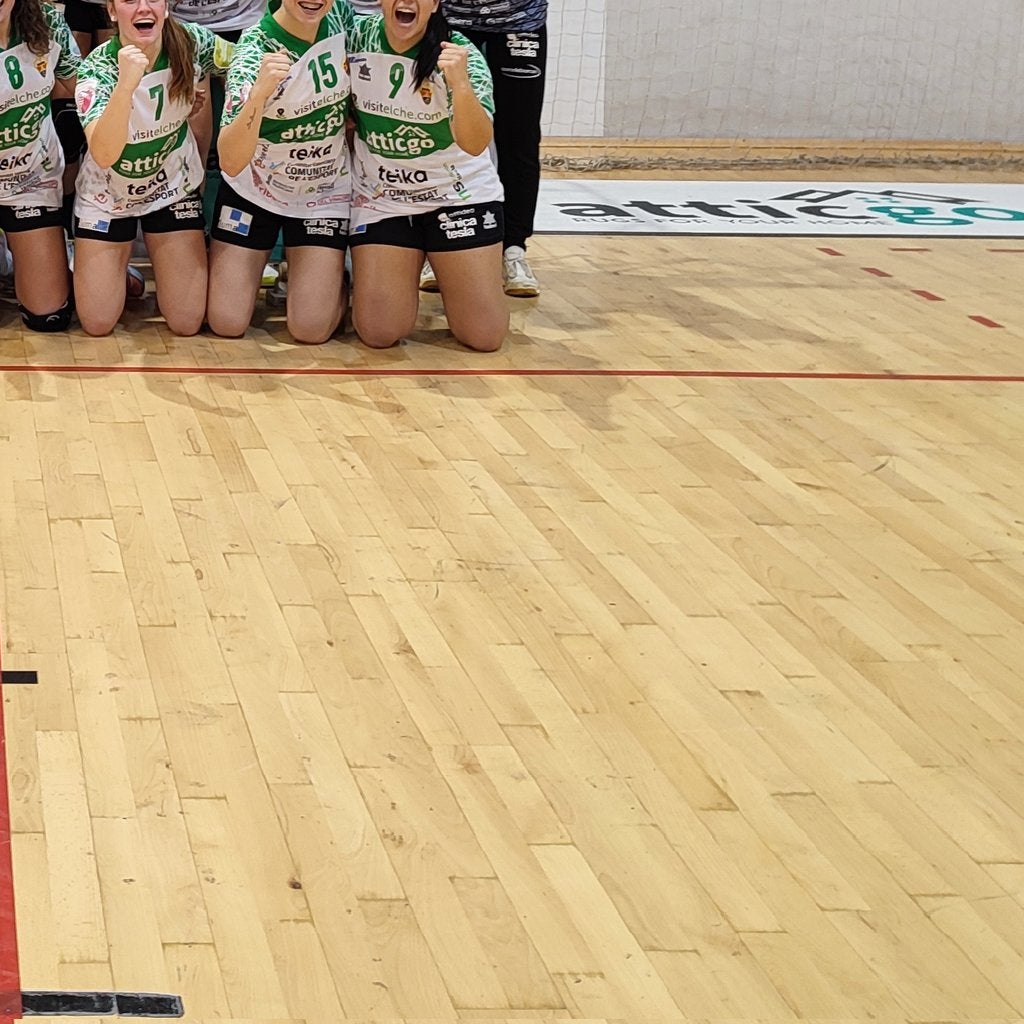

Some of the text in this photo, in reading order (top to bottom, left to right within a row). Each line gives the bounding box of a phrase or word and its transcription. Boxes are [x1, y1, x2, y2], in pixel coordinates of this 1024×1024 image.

[4, 55, 24, 90] 8
[308, 51, 339, 94] 15
[388, 62, 405, 99] 9
[148, 83, 164, 121] 7
[294, 86, 351, 116] visitelche.c
[362, 99, 442, 121] visitelche.com
[132, 118, 181, 141] visitelche
[119, 152, 168, 173] attic
[378, 165, 428, 185] teika
[15, 207, 41, 219] tesla
[551, 198, 1024, 226] atticgo
[446, 226, 476, 240] tesla
